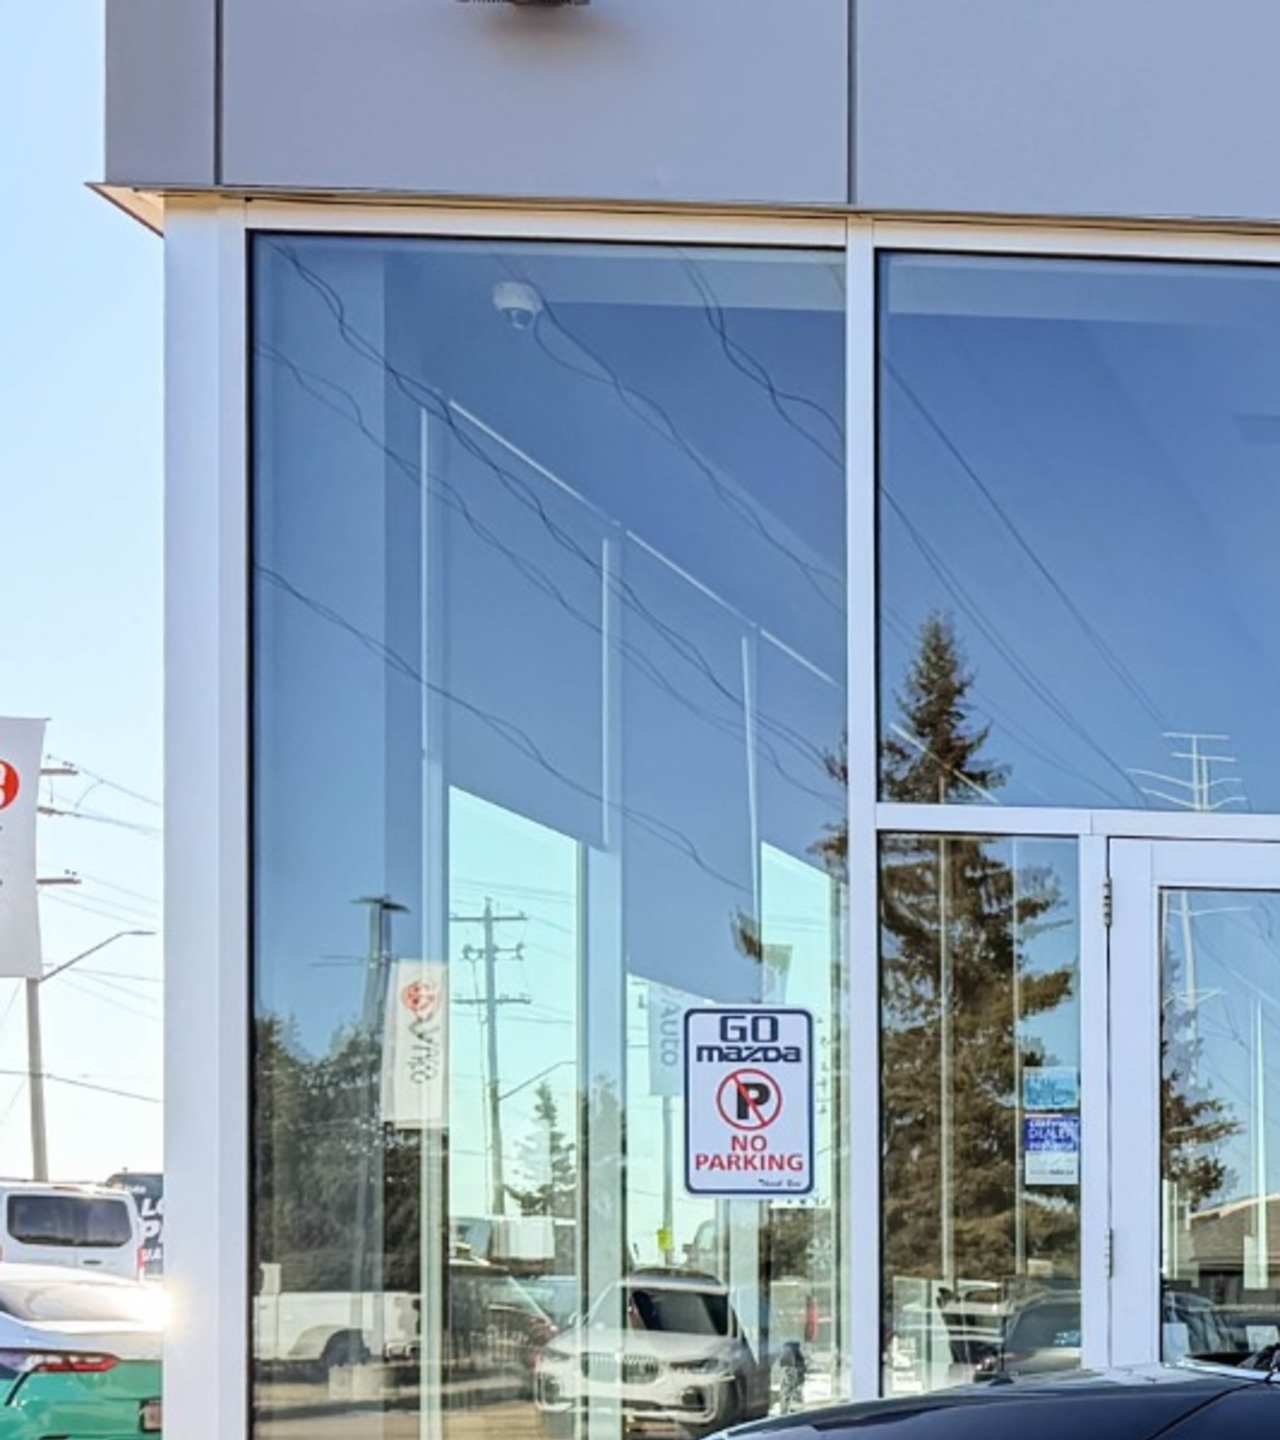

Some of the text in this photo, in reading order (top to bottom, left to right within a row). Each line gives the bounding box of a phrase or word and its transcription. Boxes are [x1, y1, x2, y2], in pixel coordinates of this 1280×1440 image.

[719, 1015, 779, 1043] GO
[731, 1135, 767, 1151] NO
[695, 1153, 804, 1172] PARKING
